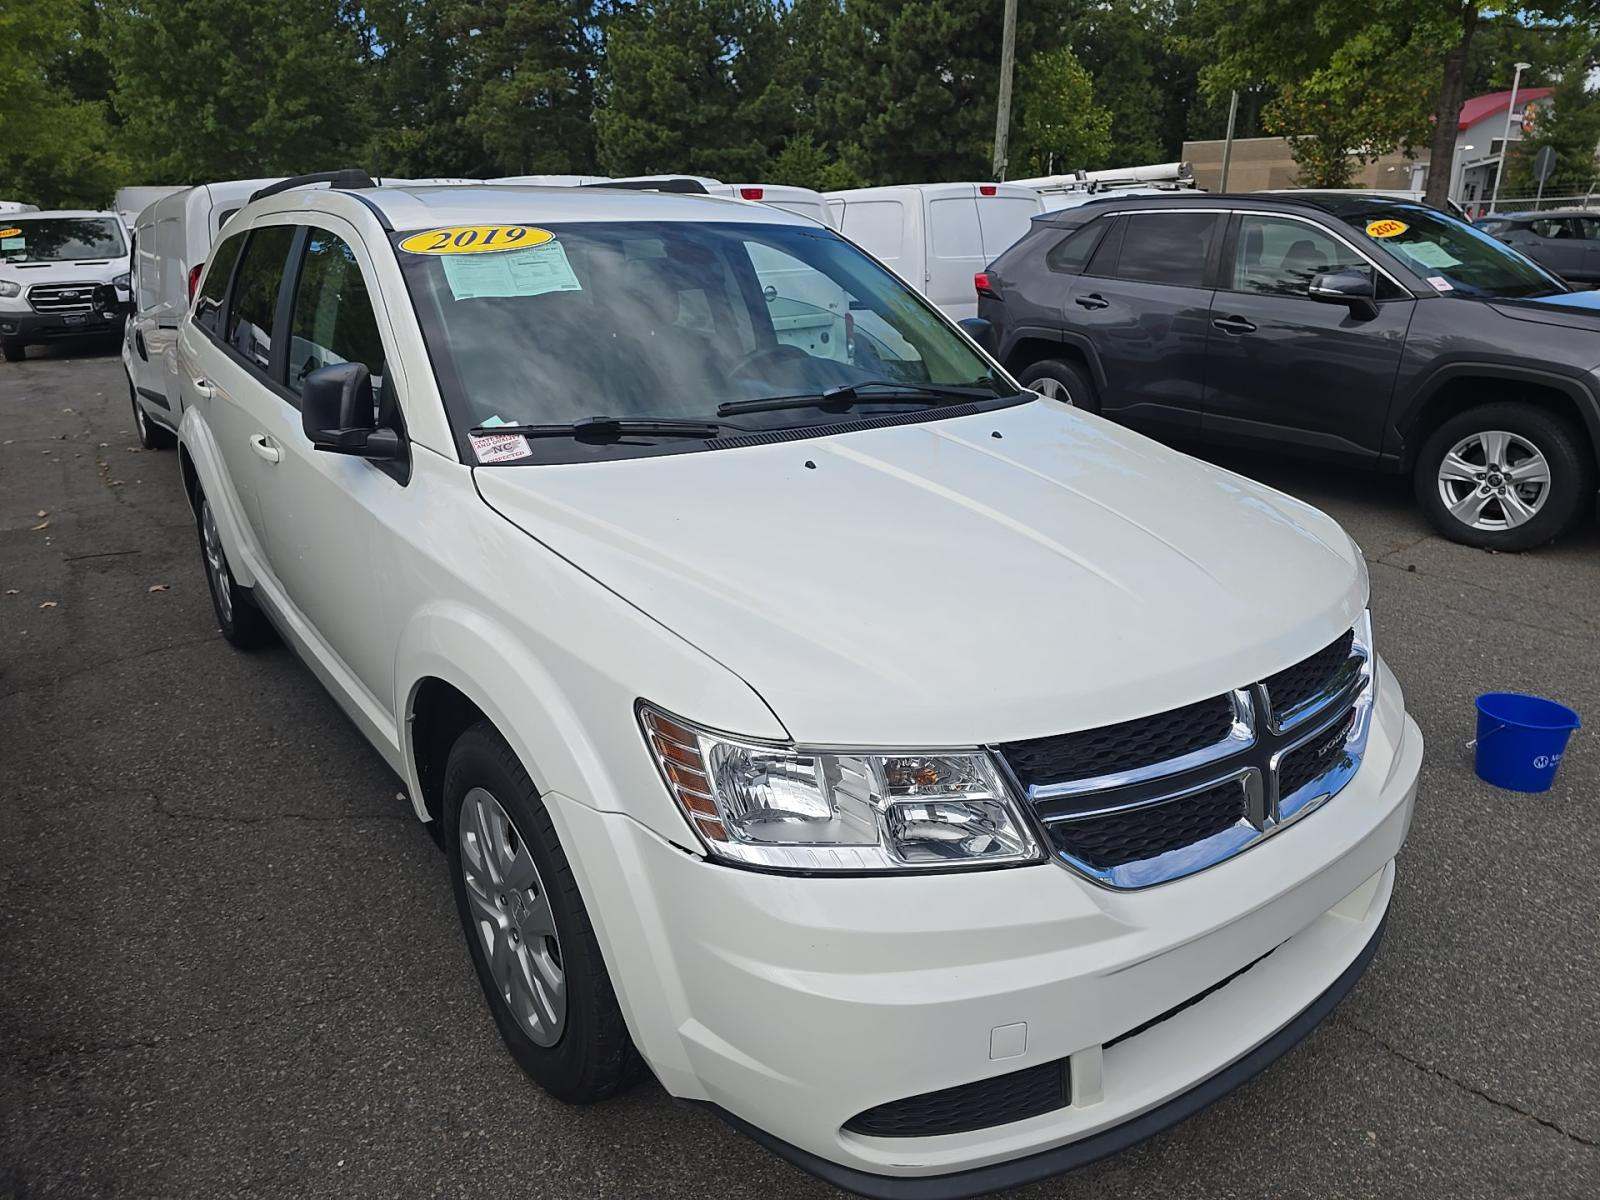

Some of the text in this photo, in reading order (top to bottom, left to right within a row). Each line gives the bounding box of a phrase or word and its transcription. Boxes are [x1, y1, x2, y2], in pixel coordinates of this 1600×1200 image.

[1371, 221, 1401, 236] 2021
[426, 228, 527, 250] 2019
[493, 443, 513, 454] NC
